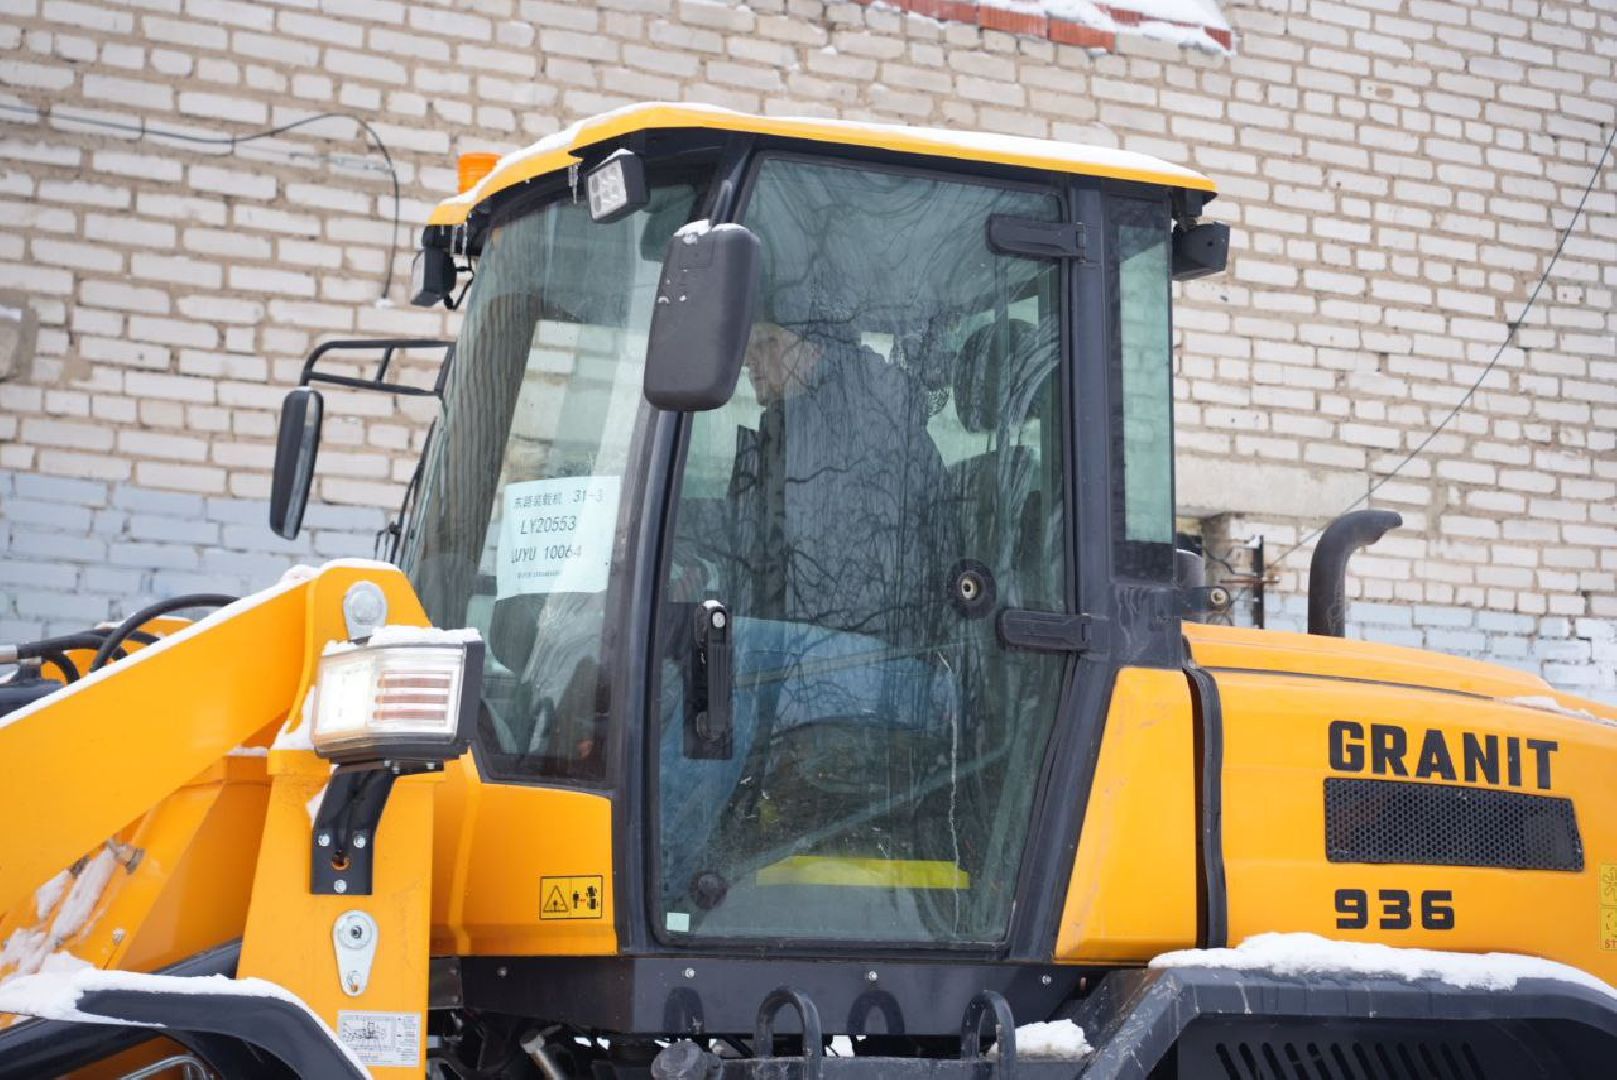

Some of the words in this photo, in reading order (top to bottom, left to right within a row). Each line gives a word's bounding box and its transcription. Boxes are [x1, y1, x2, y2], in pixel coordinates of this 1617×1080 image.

[520, 515, 577, 535] LY20553
[1328, 720, 1558, 789] GRANIT
[1334, 888, 1455, 930] 936
